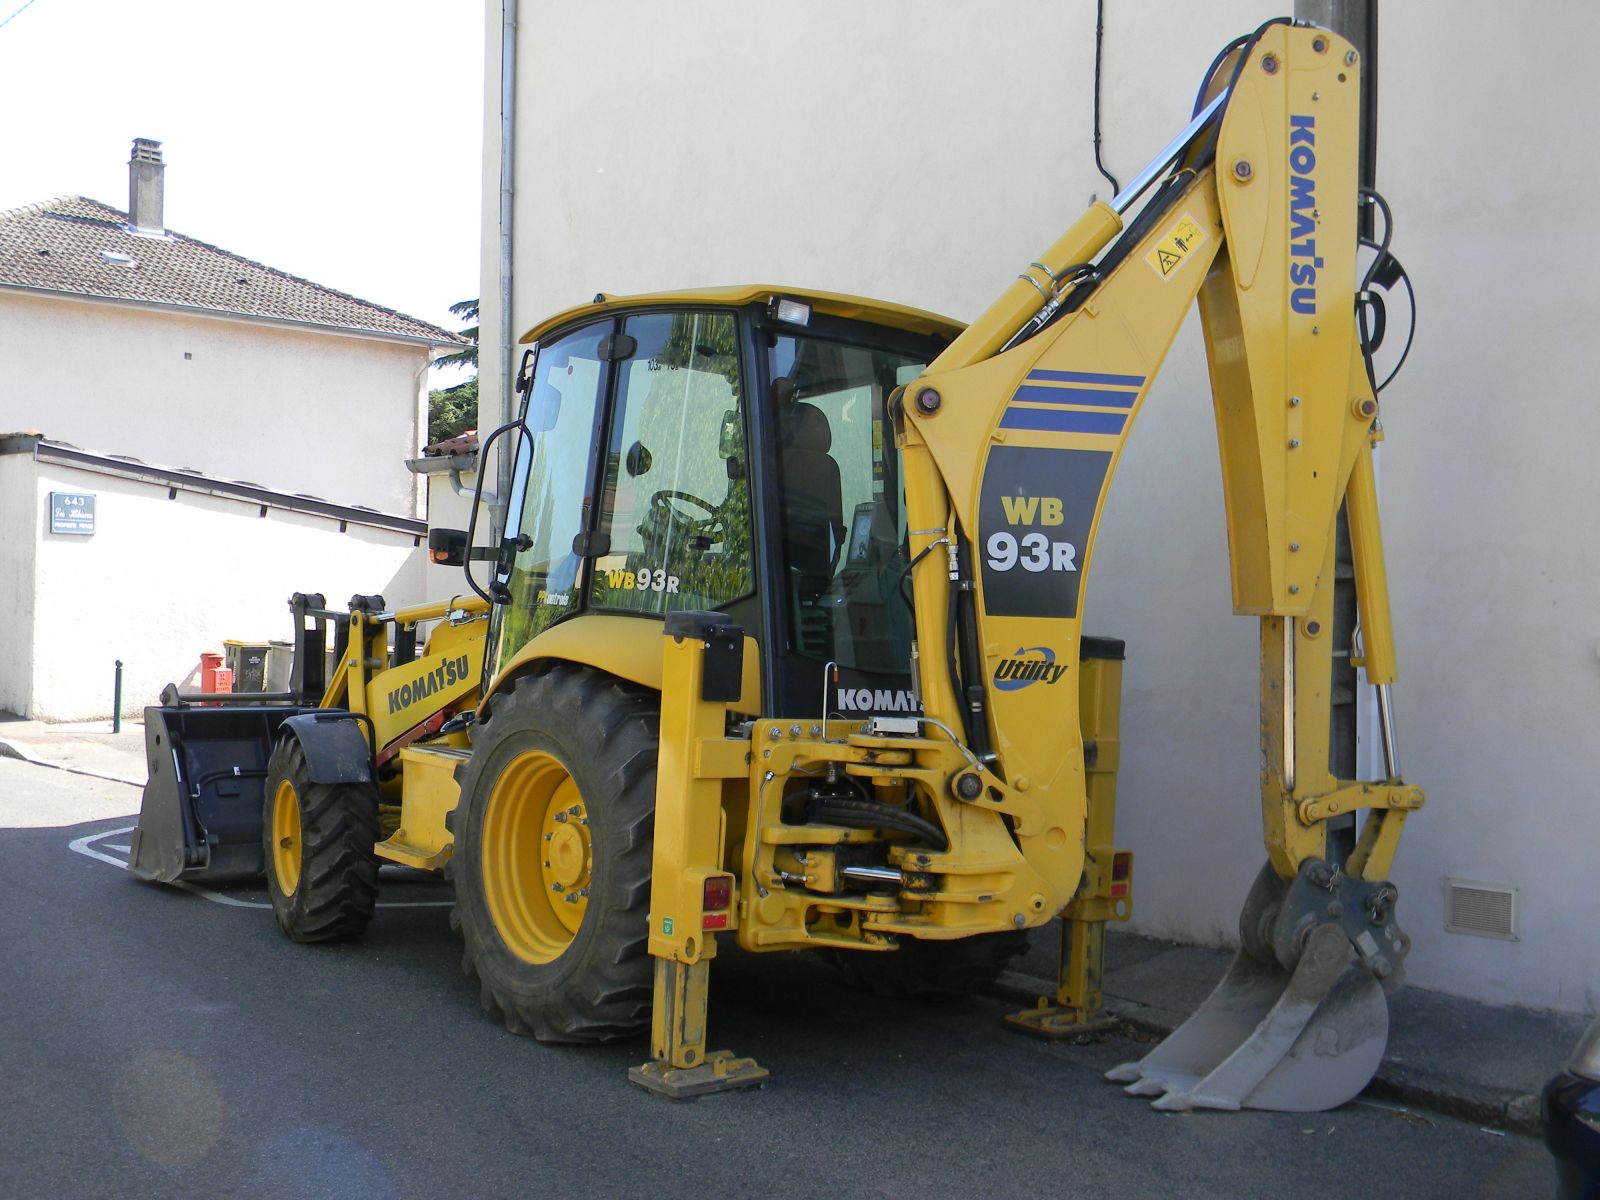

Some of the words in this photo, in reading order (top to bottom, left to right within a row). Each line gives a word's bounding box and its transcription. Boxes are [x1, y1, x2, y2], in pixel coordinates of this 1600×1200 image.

[1289, 115, 1324, 315] KOMATSU
[64, 497, 85, 506] 643
[1001, 496, 1064, 526] WB
[986, 532, 1077, 573] 93R
[388, 654, 469, 715] KOMATSU
[994, 659, 1069, 685] Utility
